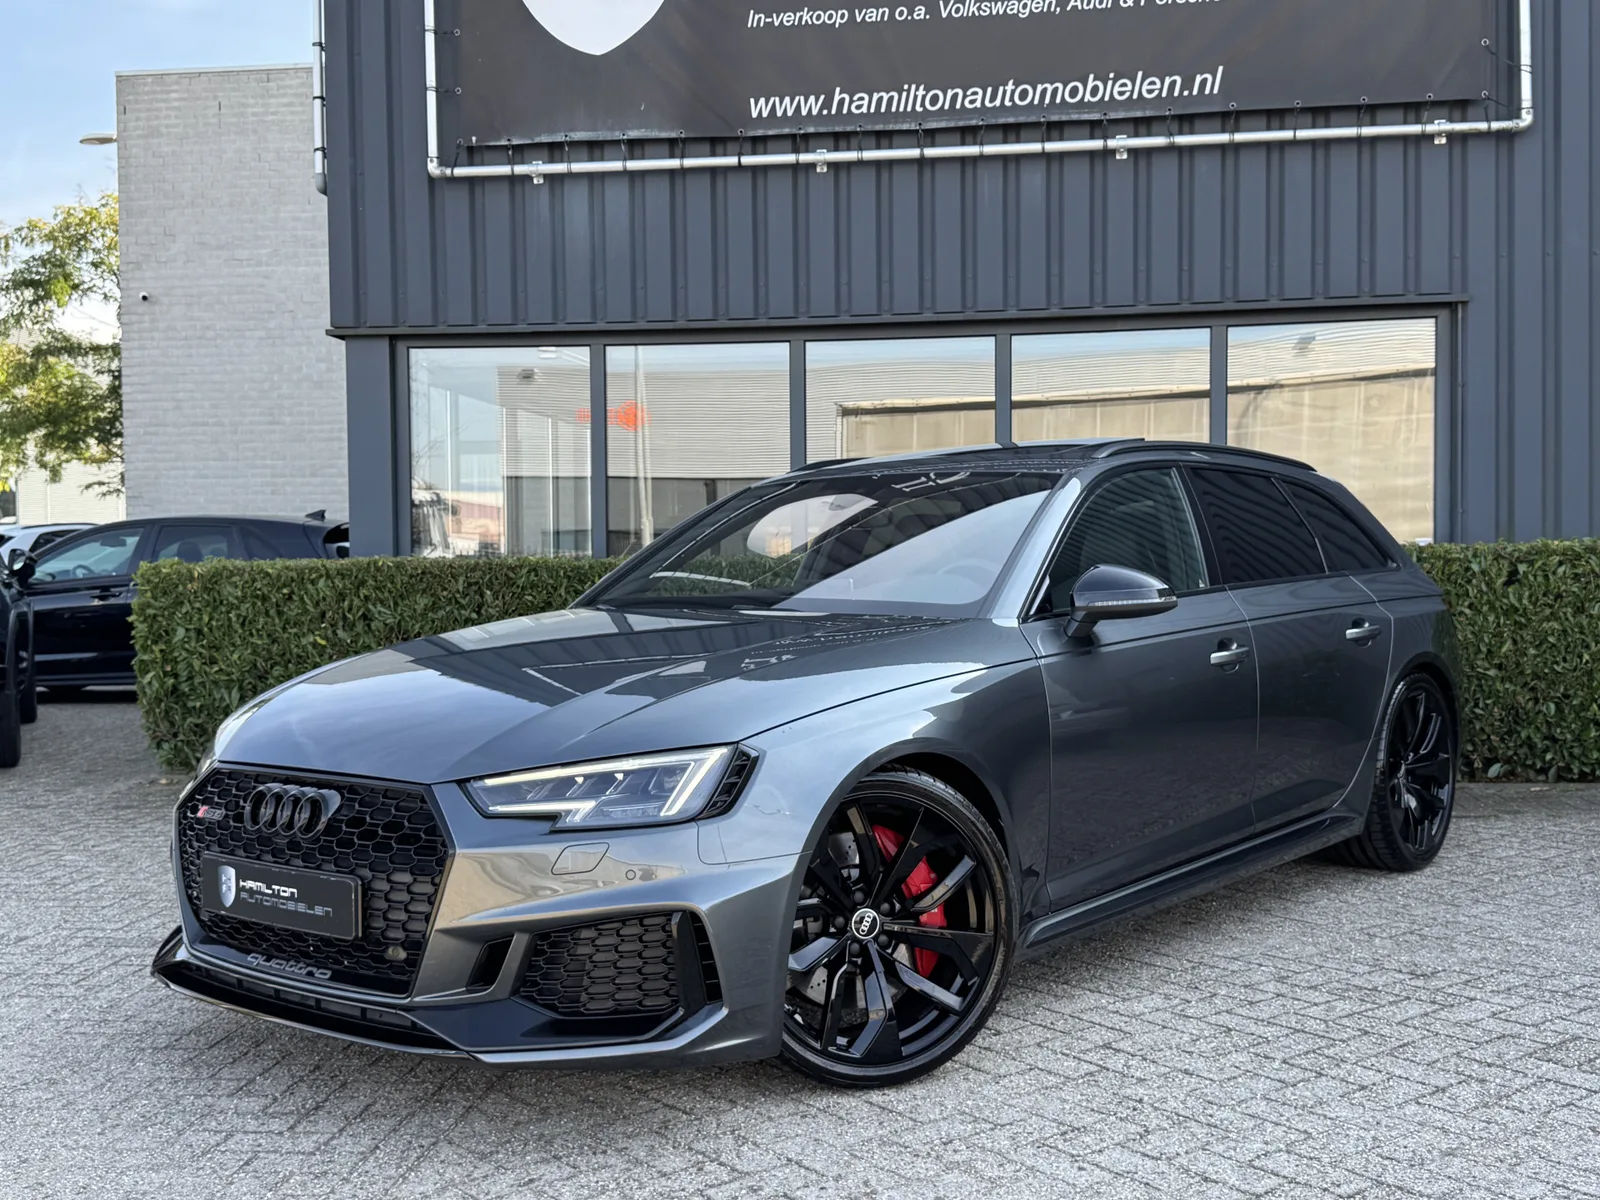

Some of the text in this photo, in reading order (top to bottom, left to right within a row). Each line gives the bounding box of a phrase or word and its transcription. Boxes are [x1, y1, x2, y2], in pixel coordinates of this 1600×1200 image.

[747, 7, 849, 28] In-verkoop
[854, 6, 889, 23] van
[895, 5, 930, 20] o.a.
[938, 0, 1061, 18] Volkswagen,
[749, 65, 1224, 119] www.hamiltonautomobielen.nl
[239, 879, 298, 898] HAMILTON
[240, 891, 333, 917] AUTOMOBIELEN
[247, 952, 333, 979] quattro
